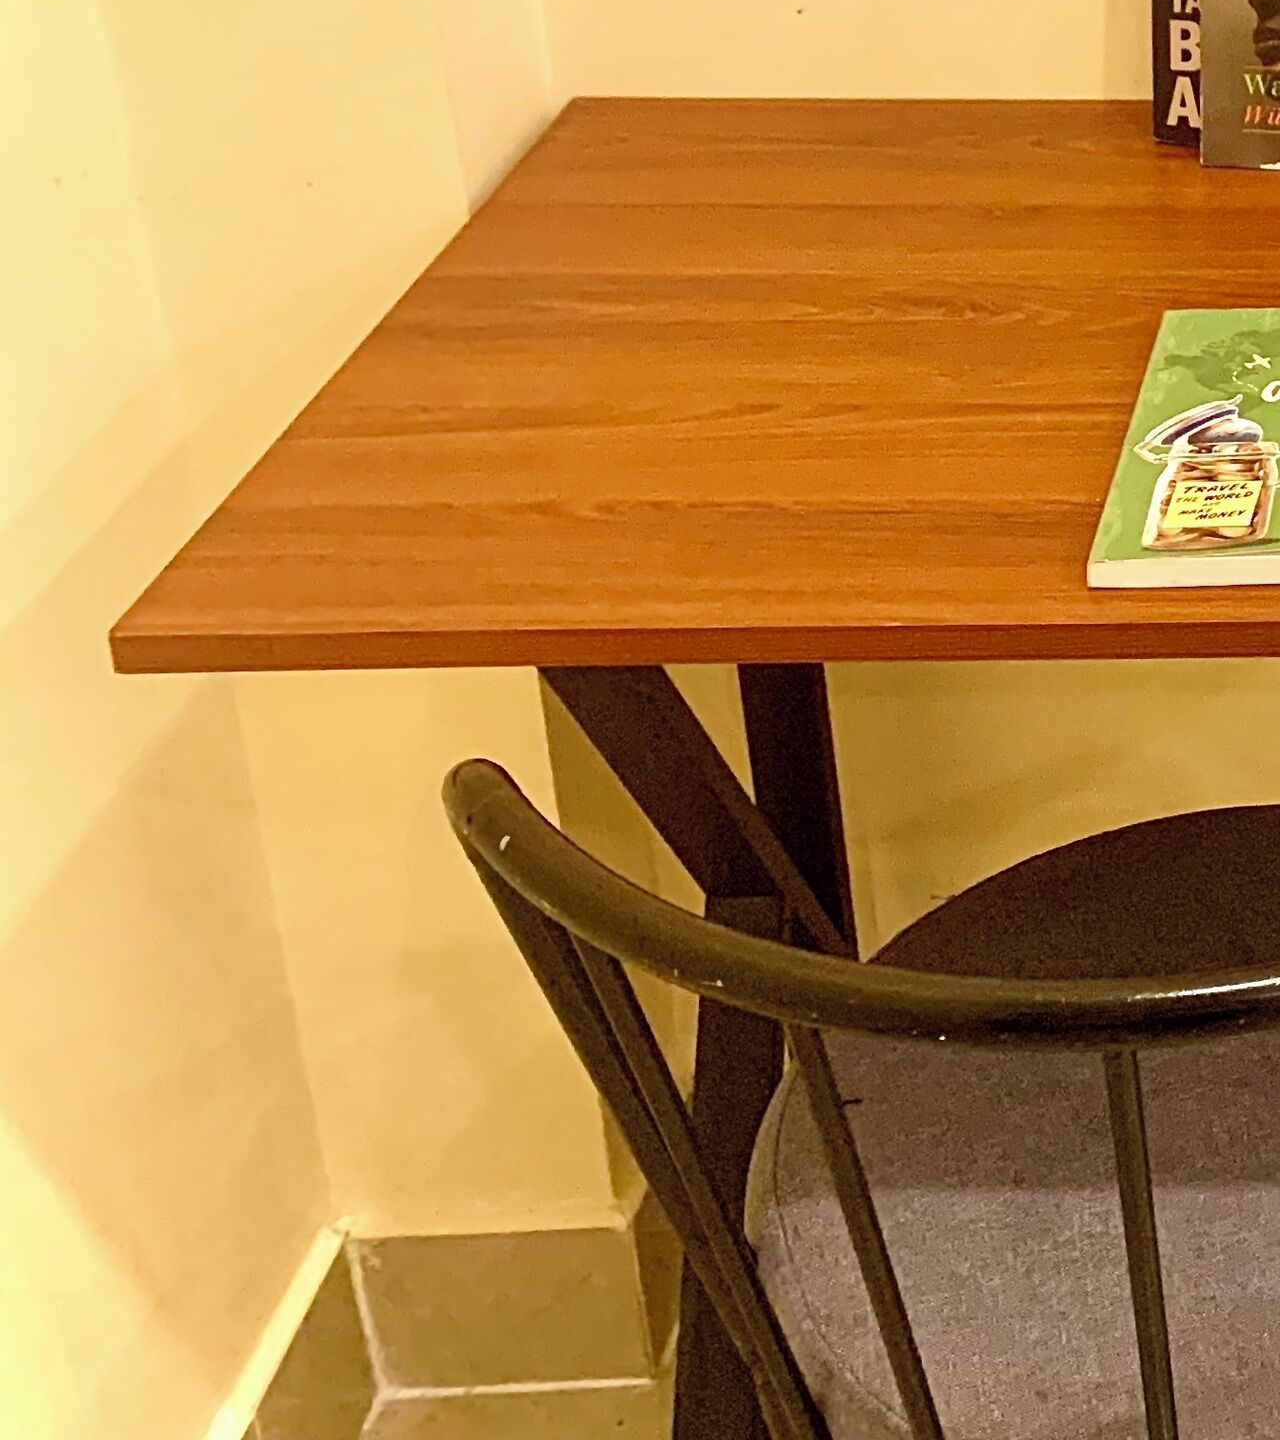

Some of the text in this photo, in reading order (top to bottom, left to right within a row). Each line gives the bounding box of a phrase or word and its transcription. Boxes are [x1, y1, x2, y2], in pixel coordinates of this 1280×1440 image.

[1169, 20, 1200, 72] B
[1166, 76, 1201, 129] A
[1184, 482, 1248, 494] TRAVEL
[1204, 490, 1254, 501] WORLD
[1194, 509, 1247, 520] MONEY
